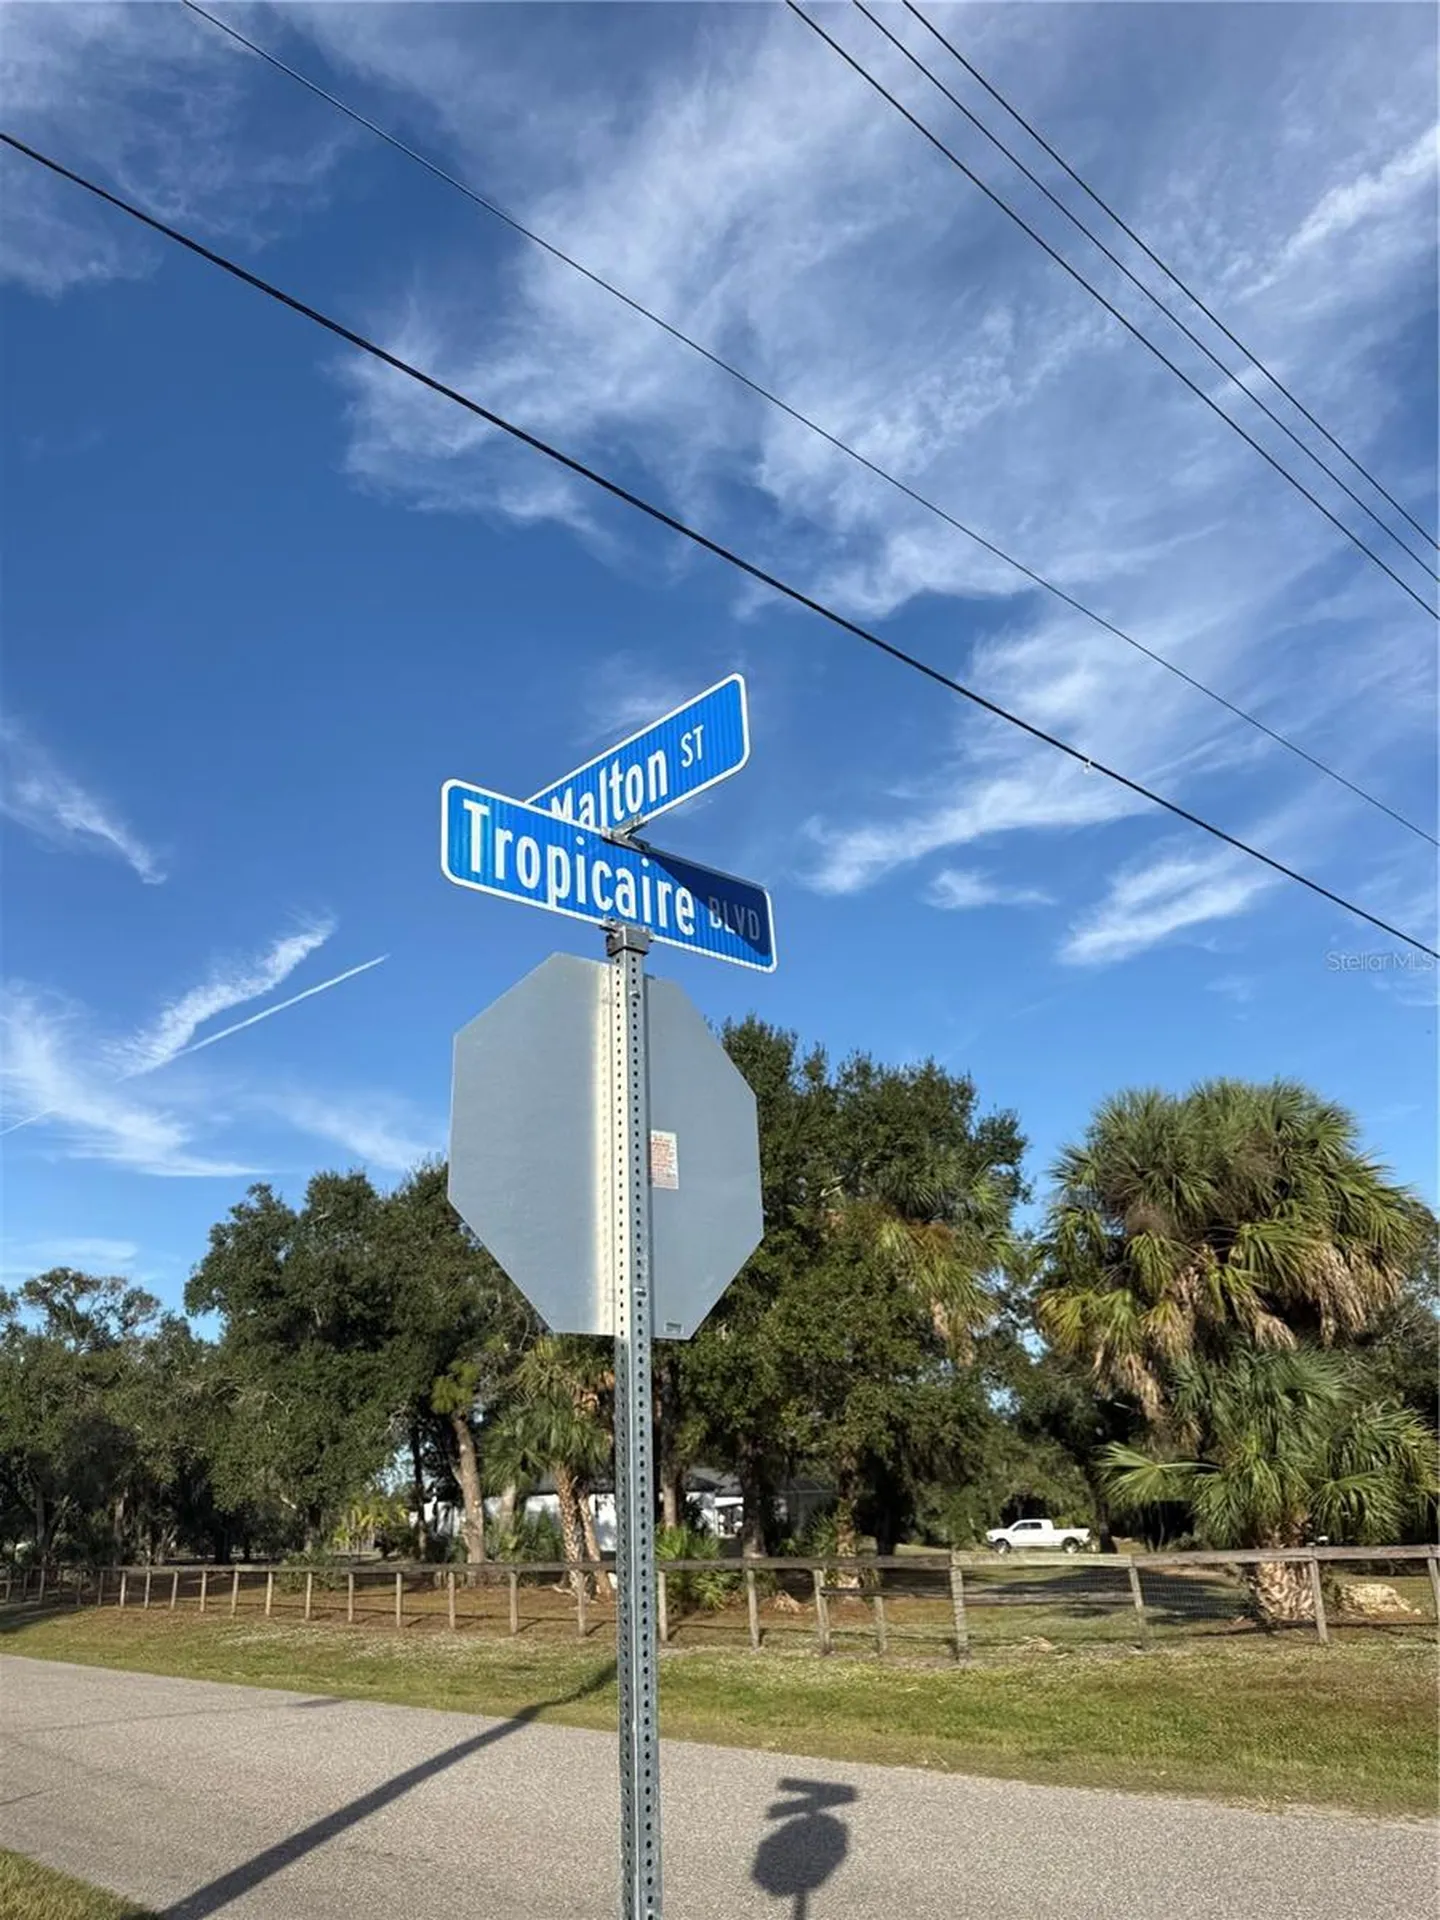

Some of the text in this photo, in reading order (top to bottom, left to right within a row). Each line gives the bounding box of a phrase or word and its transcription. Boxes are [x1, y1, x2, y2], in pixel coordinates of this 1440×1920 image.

[680, 724, 704, 768] ST
[463, 799, 761, 942] Tropicaire BLVD
